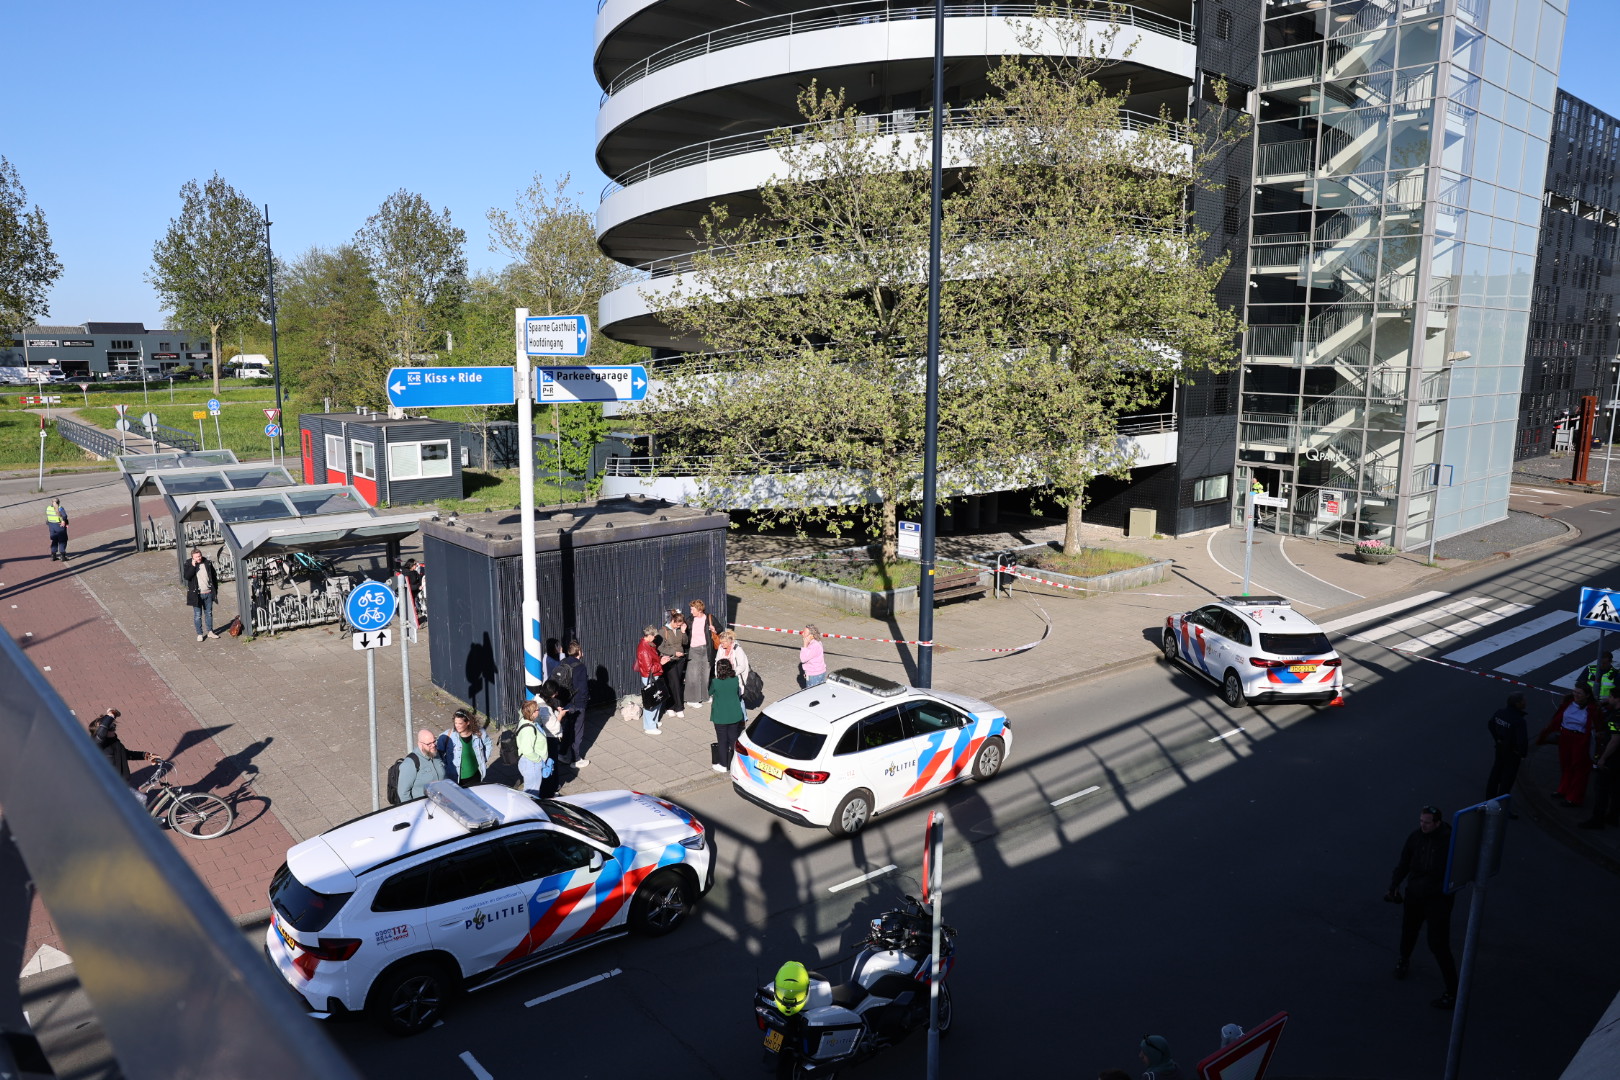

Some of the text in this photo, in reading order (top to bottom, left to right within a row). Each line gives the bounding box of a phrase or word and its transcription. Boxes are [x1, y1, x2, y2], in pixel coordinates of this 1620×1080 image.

[529, 321, 576, 334] Spaarne Gasthuis
[529, 338, 563, 350] Hoofdingang
[425, 373, 448, 383] Kiss
[459, 372, 482, 383] Ride
[557, 371, 628, 382] Parkeergarage
[885, 760, 916, 777] POLITIE
[465, 903, 524, 930] POLITIE
[392, 924, 408, 935] 112
